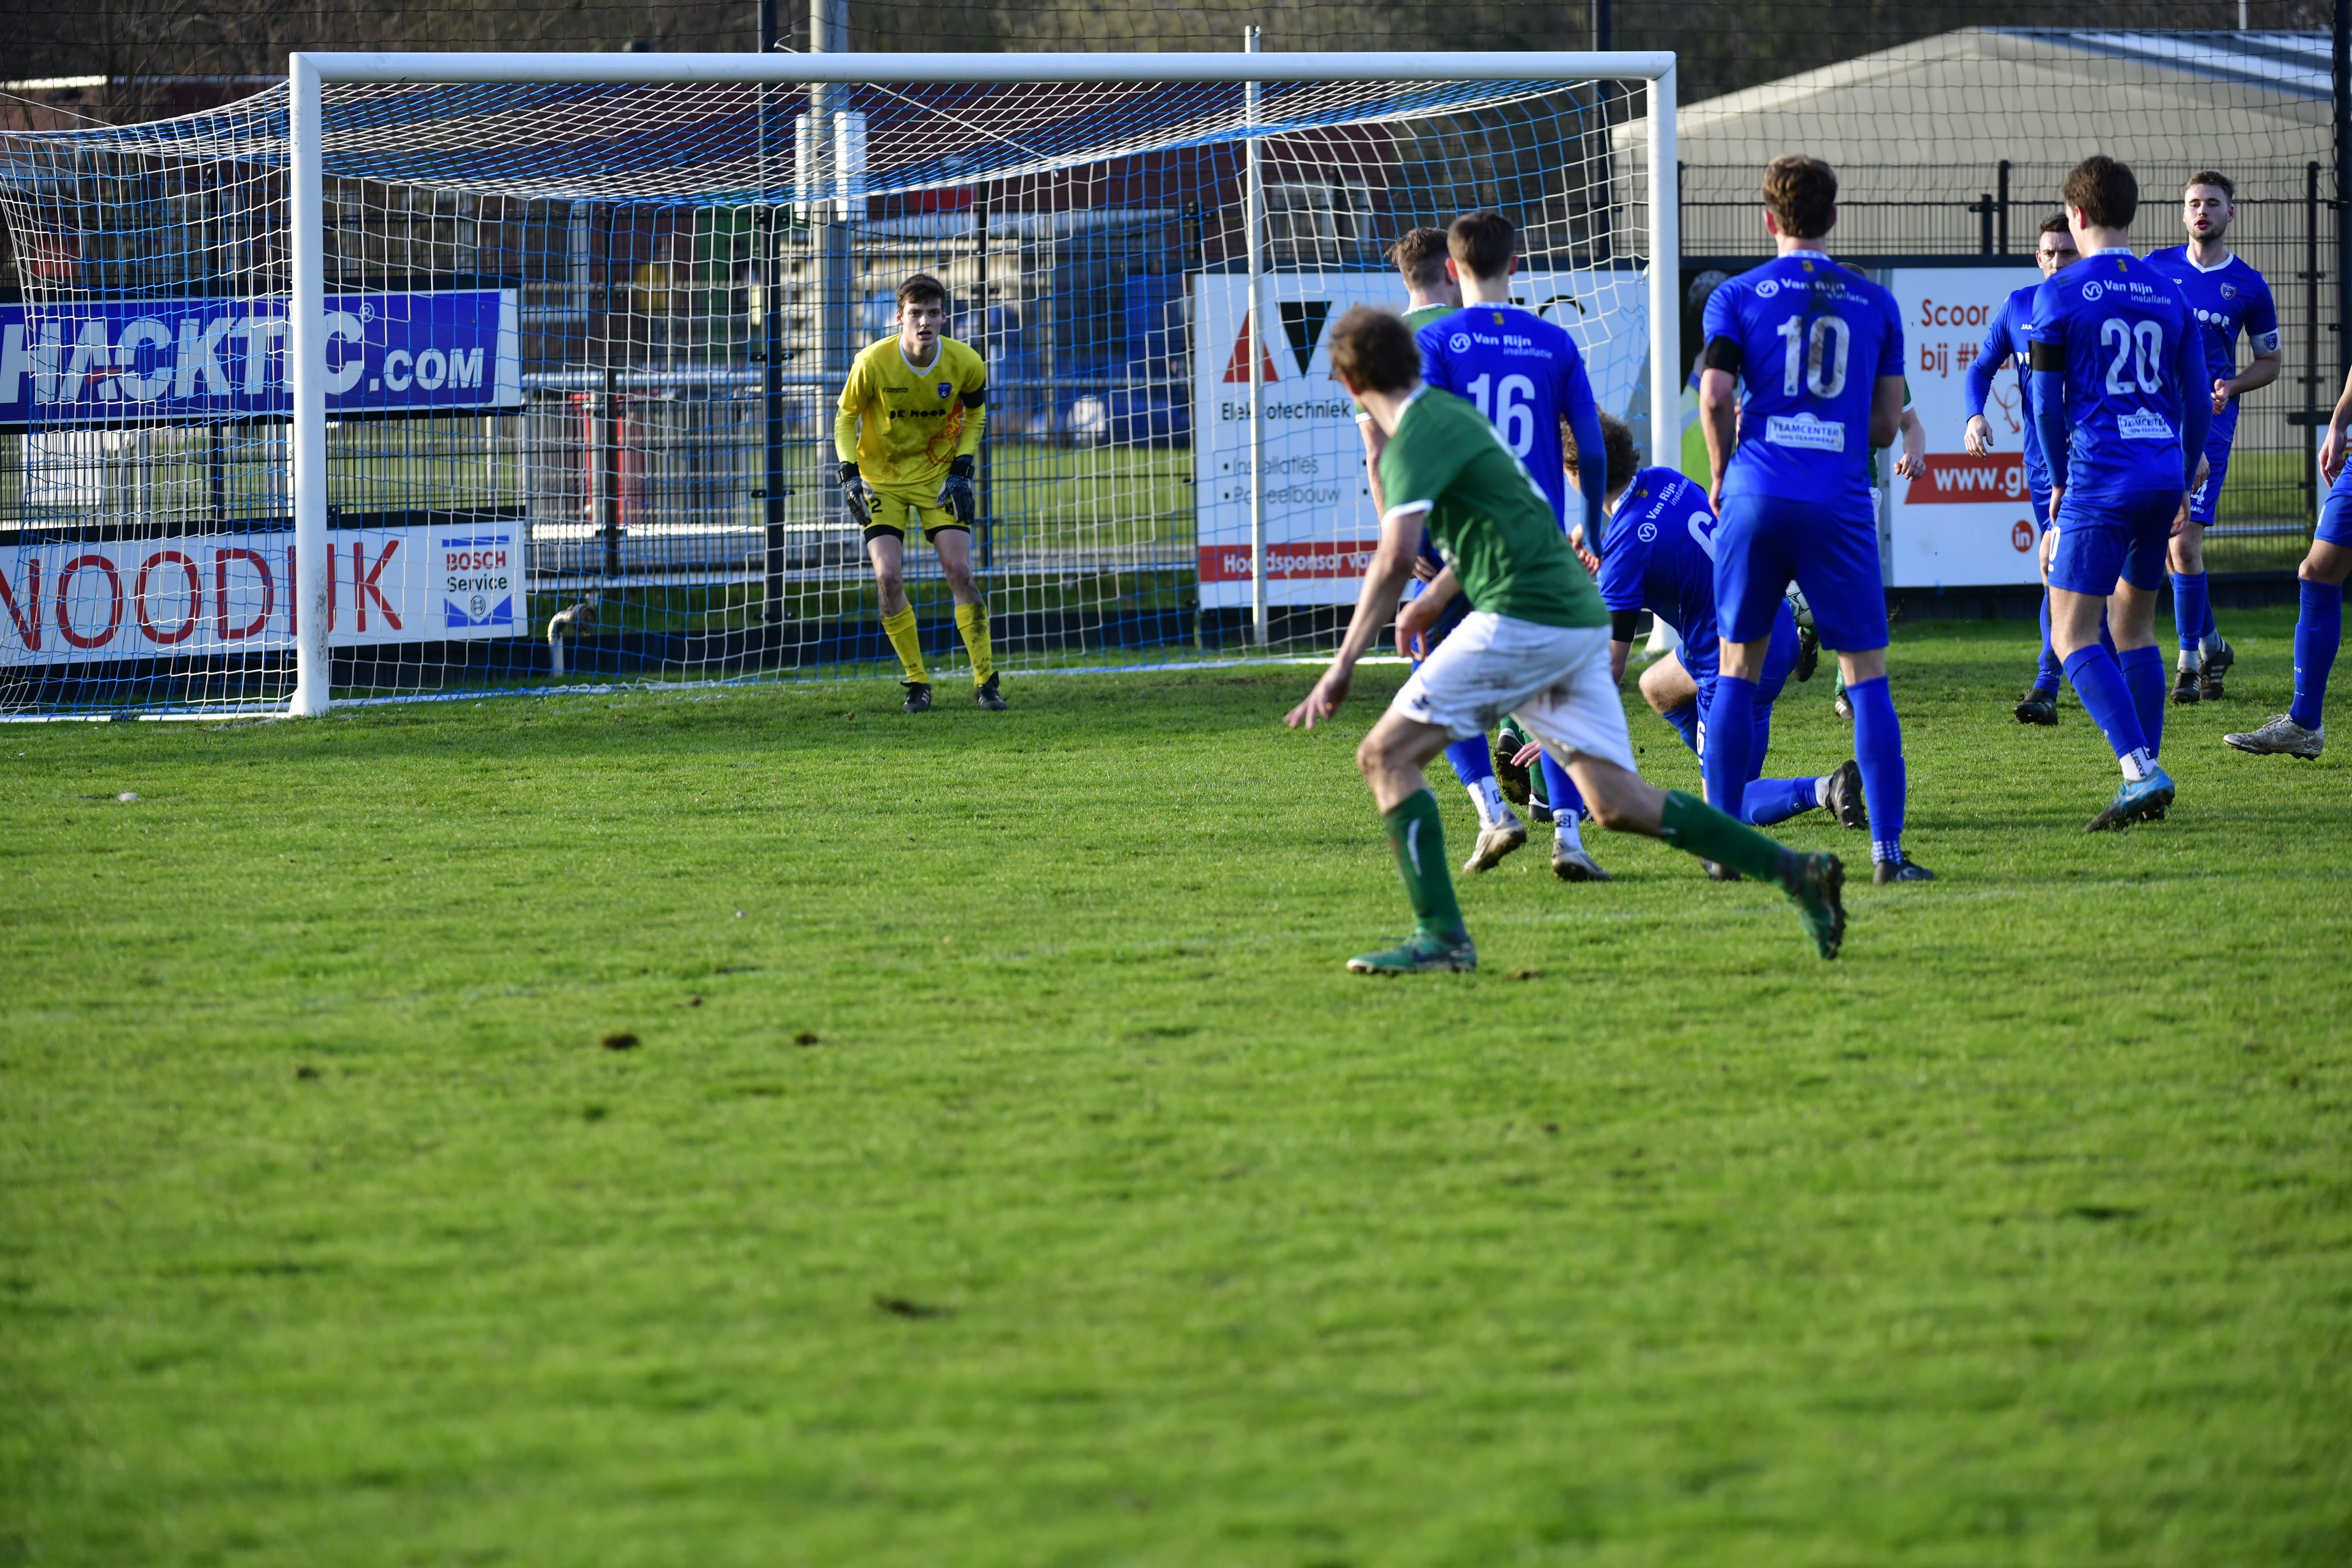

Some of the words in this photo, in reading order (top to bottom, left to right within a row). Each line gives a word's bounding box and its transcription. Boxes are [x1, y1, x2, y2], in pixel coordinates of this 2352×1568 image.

[1781, 277, 1810, 289] Van
[2103, 279, 2126, 292] Van
[2129, 282, 2153, 295] Rijn
[2131, 293, 2171, 305] installatie
[1921, 298, 1990, 326] Scoor
[1472, 332, 1499, 345] Van
[1503, 334, 1532, 347] Rijn
[1503, 347, 1553, 360] installatie
[1777, 315, 1851, 399] 10
[1921, 342, 1948, 378] bij
[2101, 317, 2163, 395] 20
[1222, 400, 1351, 420] Elekotechniek
[1467, 373, 1536, 459] 16
[1233, 454, 1319, 476] Insallaties
[1234, 485, 1342, 505] Paeelbouw
[1645, 501, 1665, 519] Van
[1659, 483, 1676, 501] Rijn
[2190, 505, 2204, 514] JAKO
[447, 550, 506, 571] BOSCH
[1224, 550, 1344, 575] Hoodsponsor
[447, 574, 508, 592] Service
[1697, 720, 1705, 756] 6
